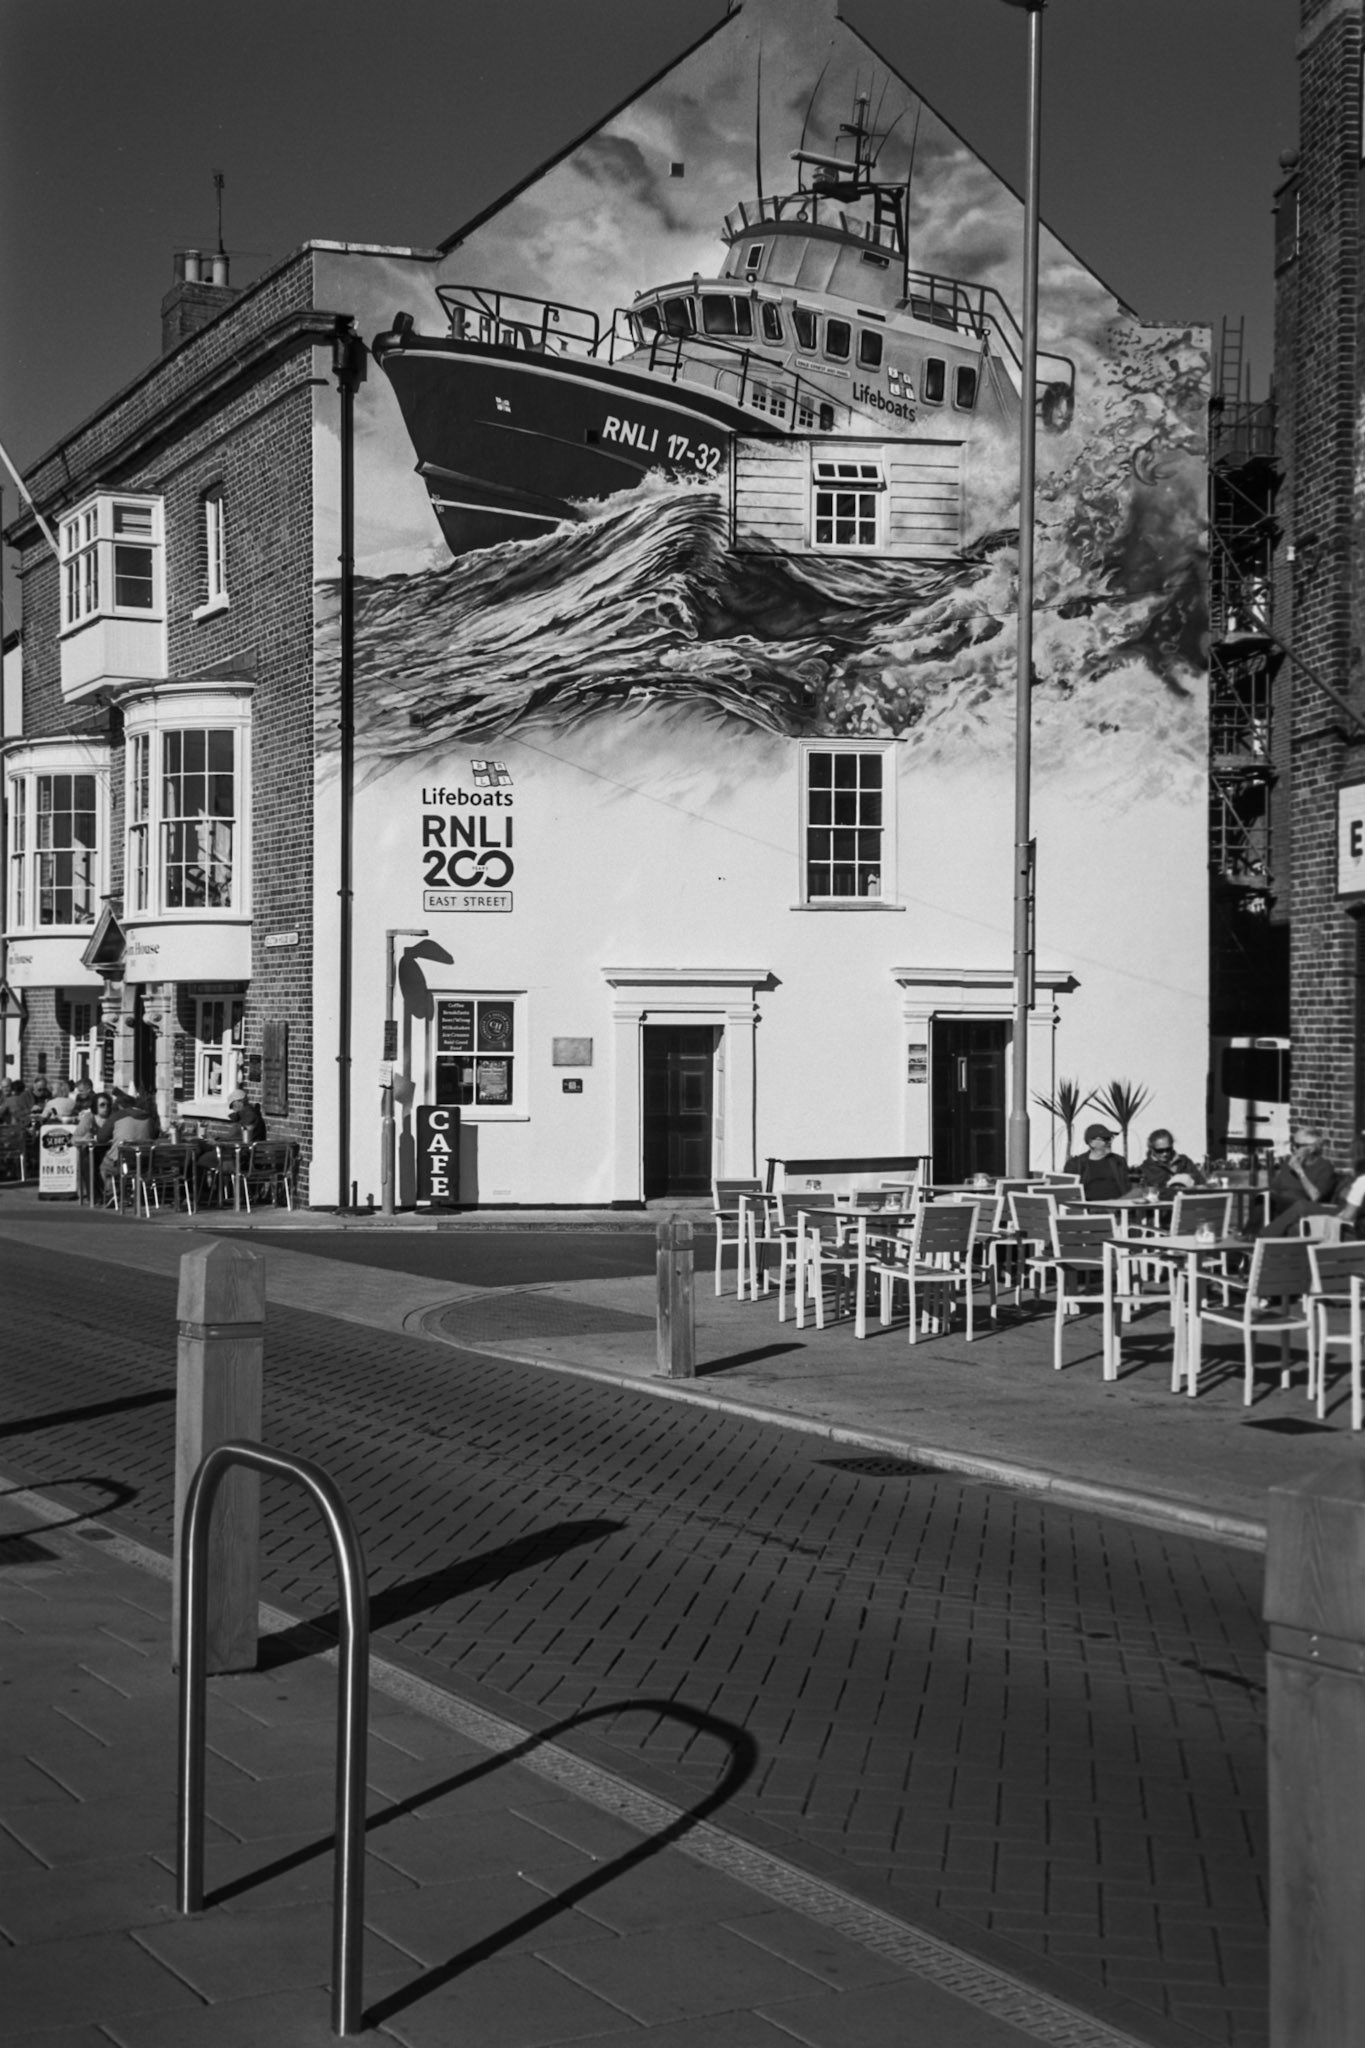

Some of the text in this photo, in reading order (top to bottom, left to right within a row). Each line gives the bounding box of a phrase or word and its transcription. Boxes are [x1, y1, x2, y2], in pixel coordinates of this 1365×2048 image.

[853, 382, 916, 422] Lifeboats
[602, 415, 721, 477] RNLI 17-32
[422, 788, 514, 806] Lifeboats
[422, 815, 513, 848] RNLI
[422, 850, 514, 888] 200
[429, 896, 507, 907] EAST STREET
[135, 942, 160, 955] House
[42, 1165, 74, 1175] FOR DOGS
[427, 1110, 452, 1197] CAFE
